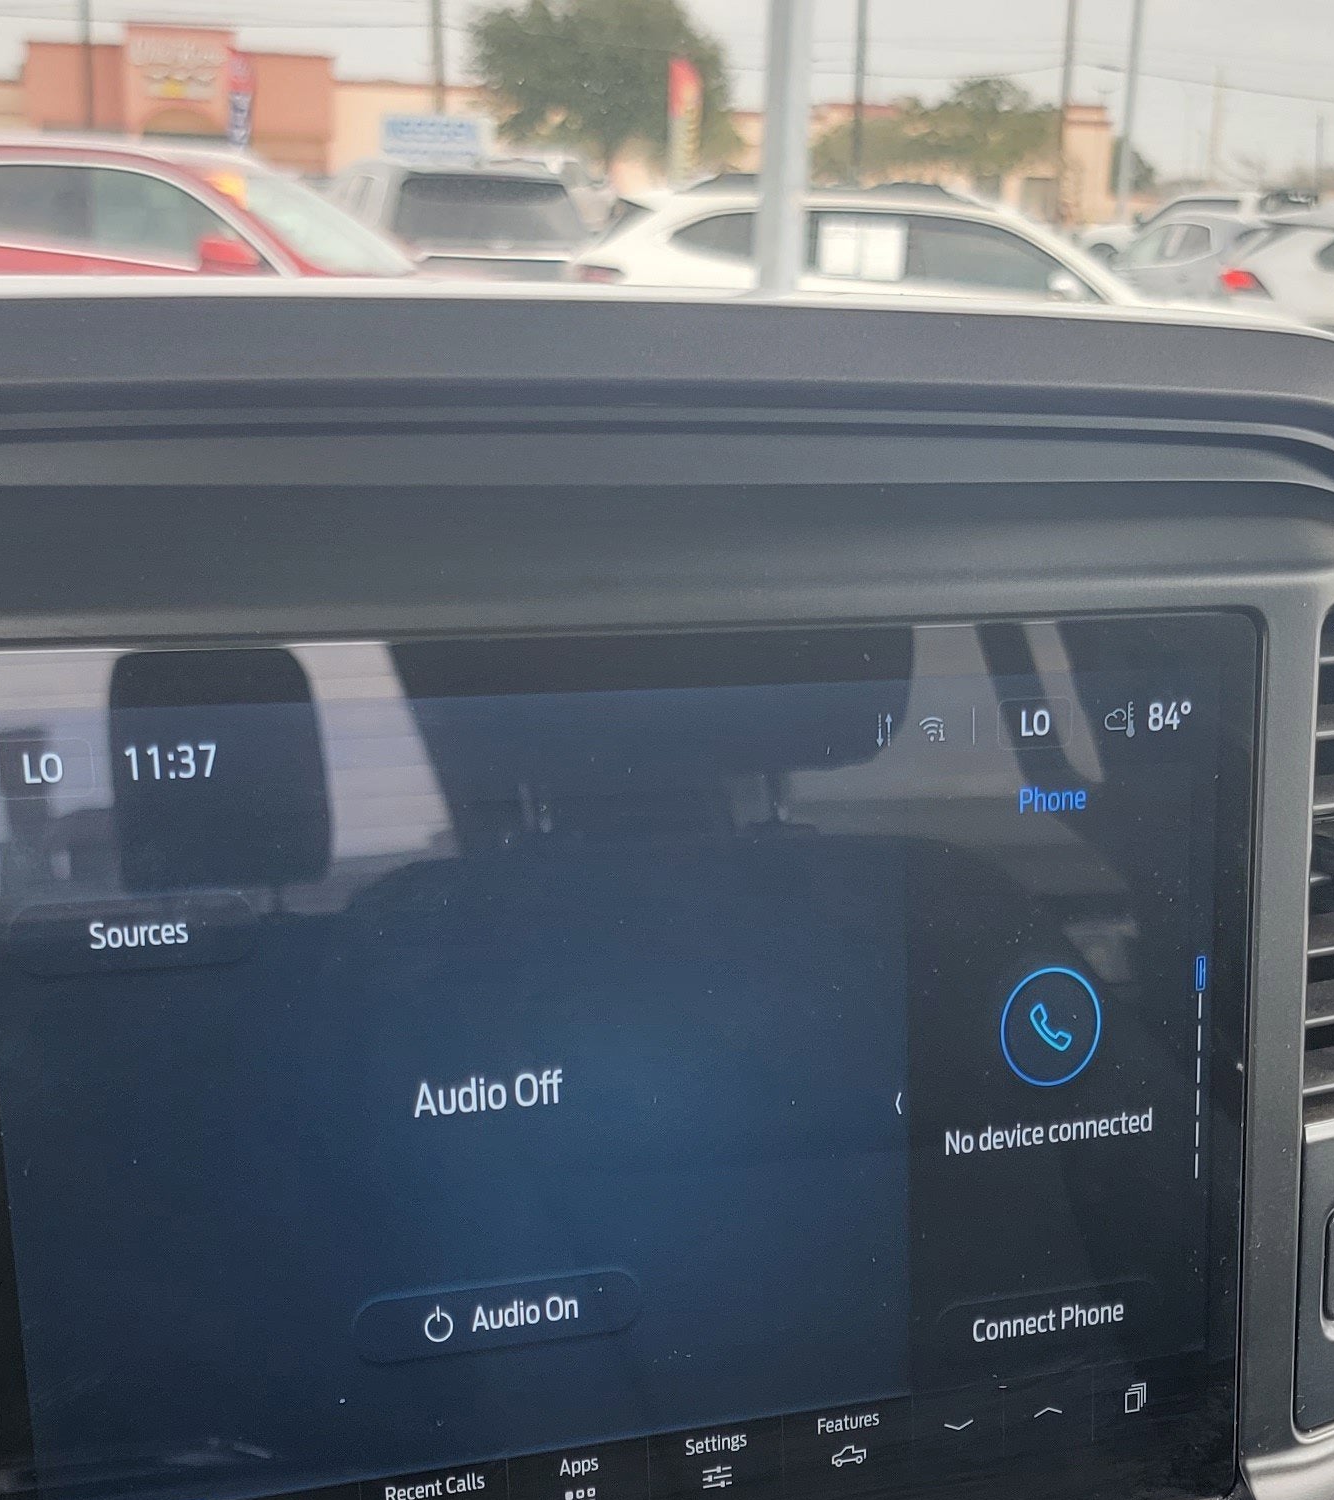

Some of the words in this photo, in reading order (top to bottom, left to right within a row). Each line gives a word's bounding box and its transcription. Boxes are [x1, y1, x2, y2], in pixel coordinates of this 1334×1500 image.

[1020, 710, 1051, 737] LO
[22, 753, 64, 785] LO
[124, 743, 217, 781] 11:37
[1019, 786, 1087, 814] Phone
[89, 920, 189, 950] Sources
[414, 1077, 507, 1118] Audio
[515, 1068, 563, 1107] Off
[945, 1130, 974, 1156] No
[979, 1122, 1044, 1151] device
[1048, 1107, 1153, 1143] connected
[472, 1300, 540, 1332] Audio
[546, 1296, 579, 1321] On
[972, 1310, 1056, 1343] Connect
[1061, 1302, 1124, 1331] Phone
[817, 1409, 880, 1434] Features
[685, 1431, 748, 1457] Settings
[559, 1456, 599, 1479] Apps
[446, 1472, 485, 1495] Calls
